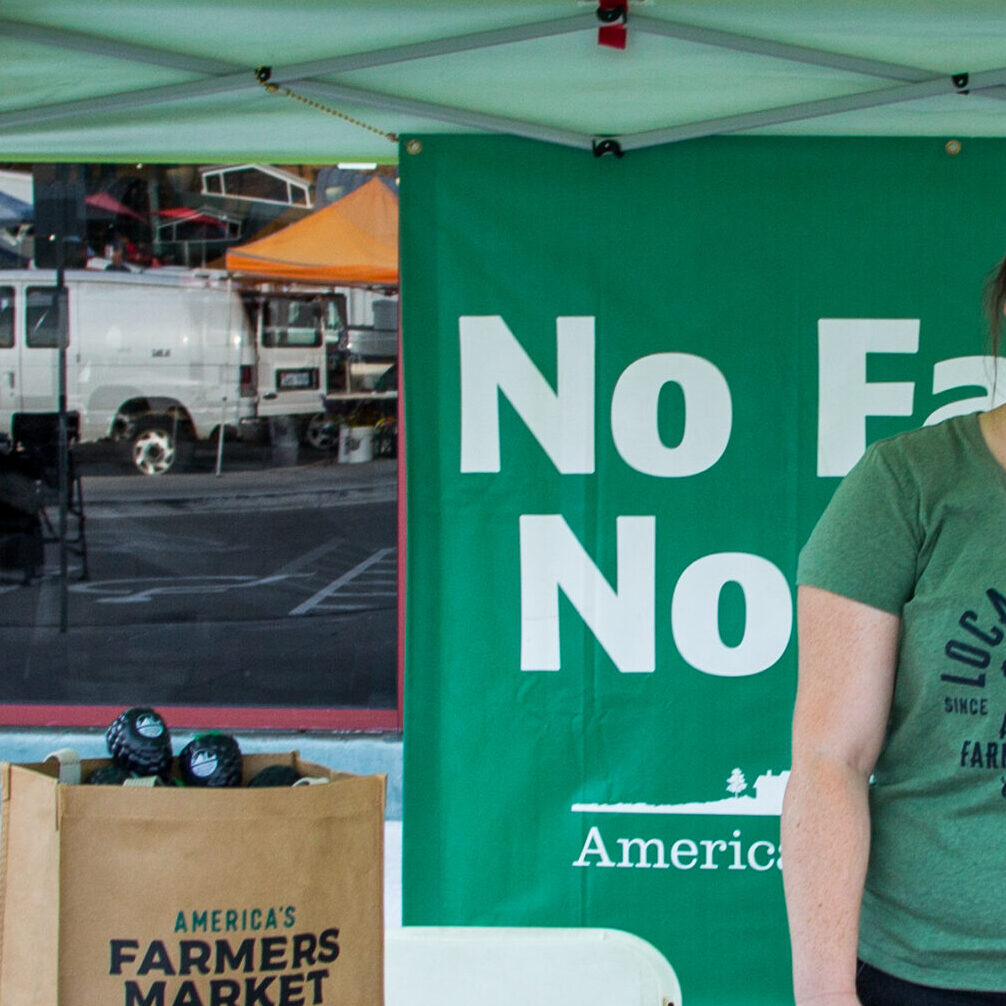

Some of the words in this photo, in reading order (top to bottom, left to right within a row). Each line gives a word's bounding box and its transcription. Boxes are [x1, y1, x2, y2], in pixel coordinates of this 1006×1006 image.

[459, 315, 733, 478] No
[519, 514, 793, 677] No
[944, 696, 988, 716] SINCE
[572, 826, 784, 871] Americ
[173, 905, 297, 933] AMERICA'S
[109, 927, 340, 976] FARMERS
